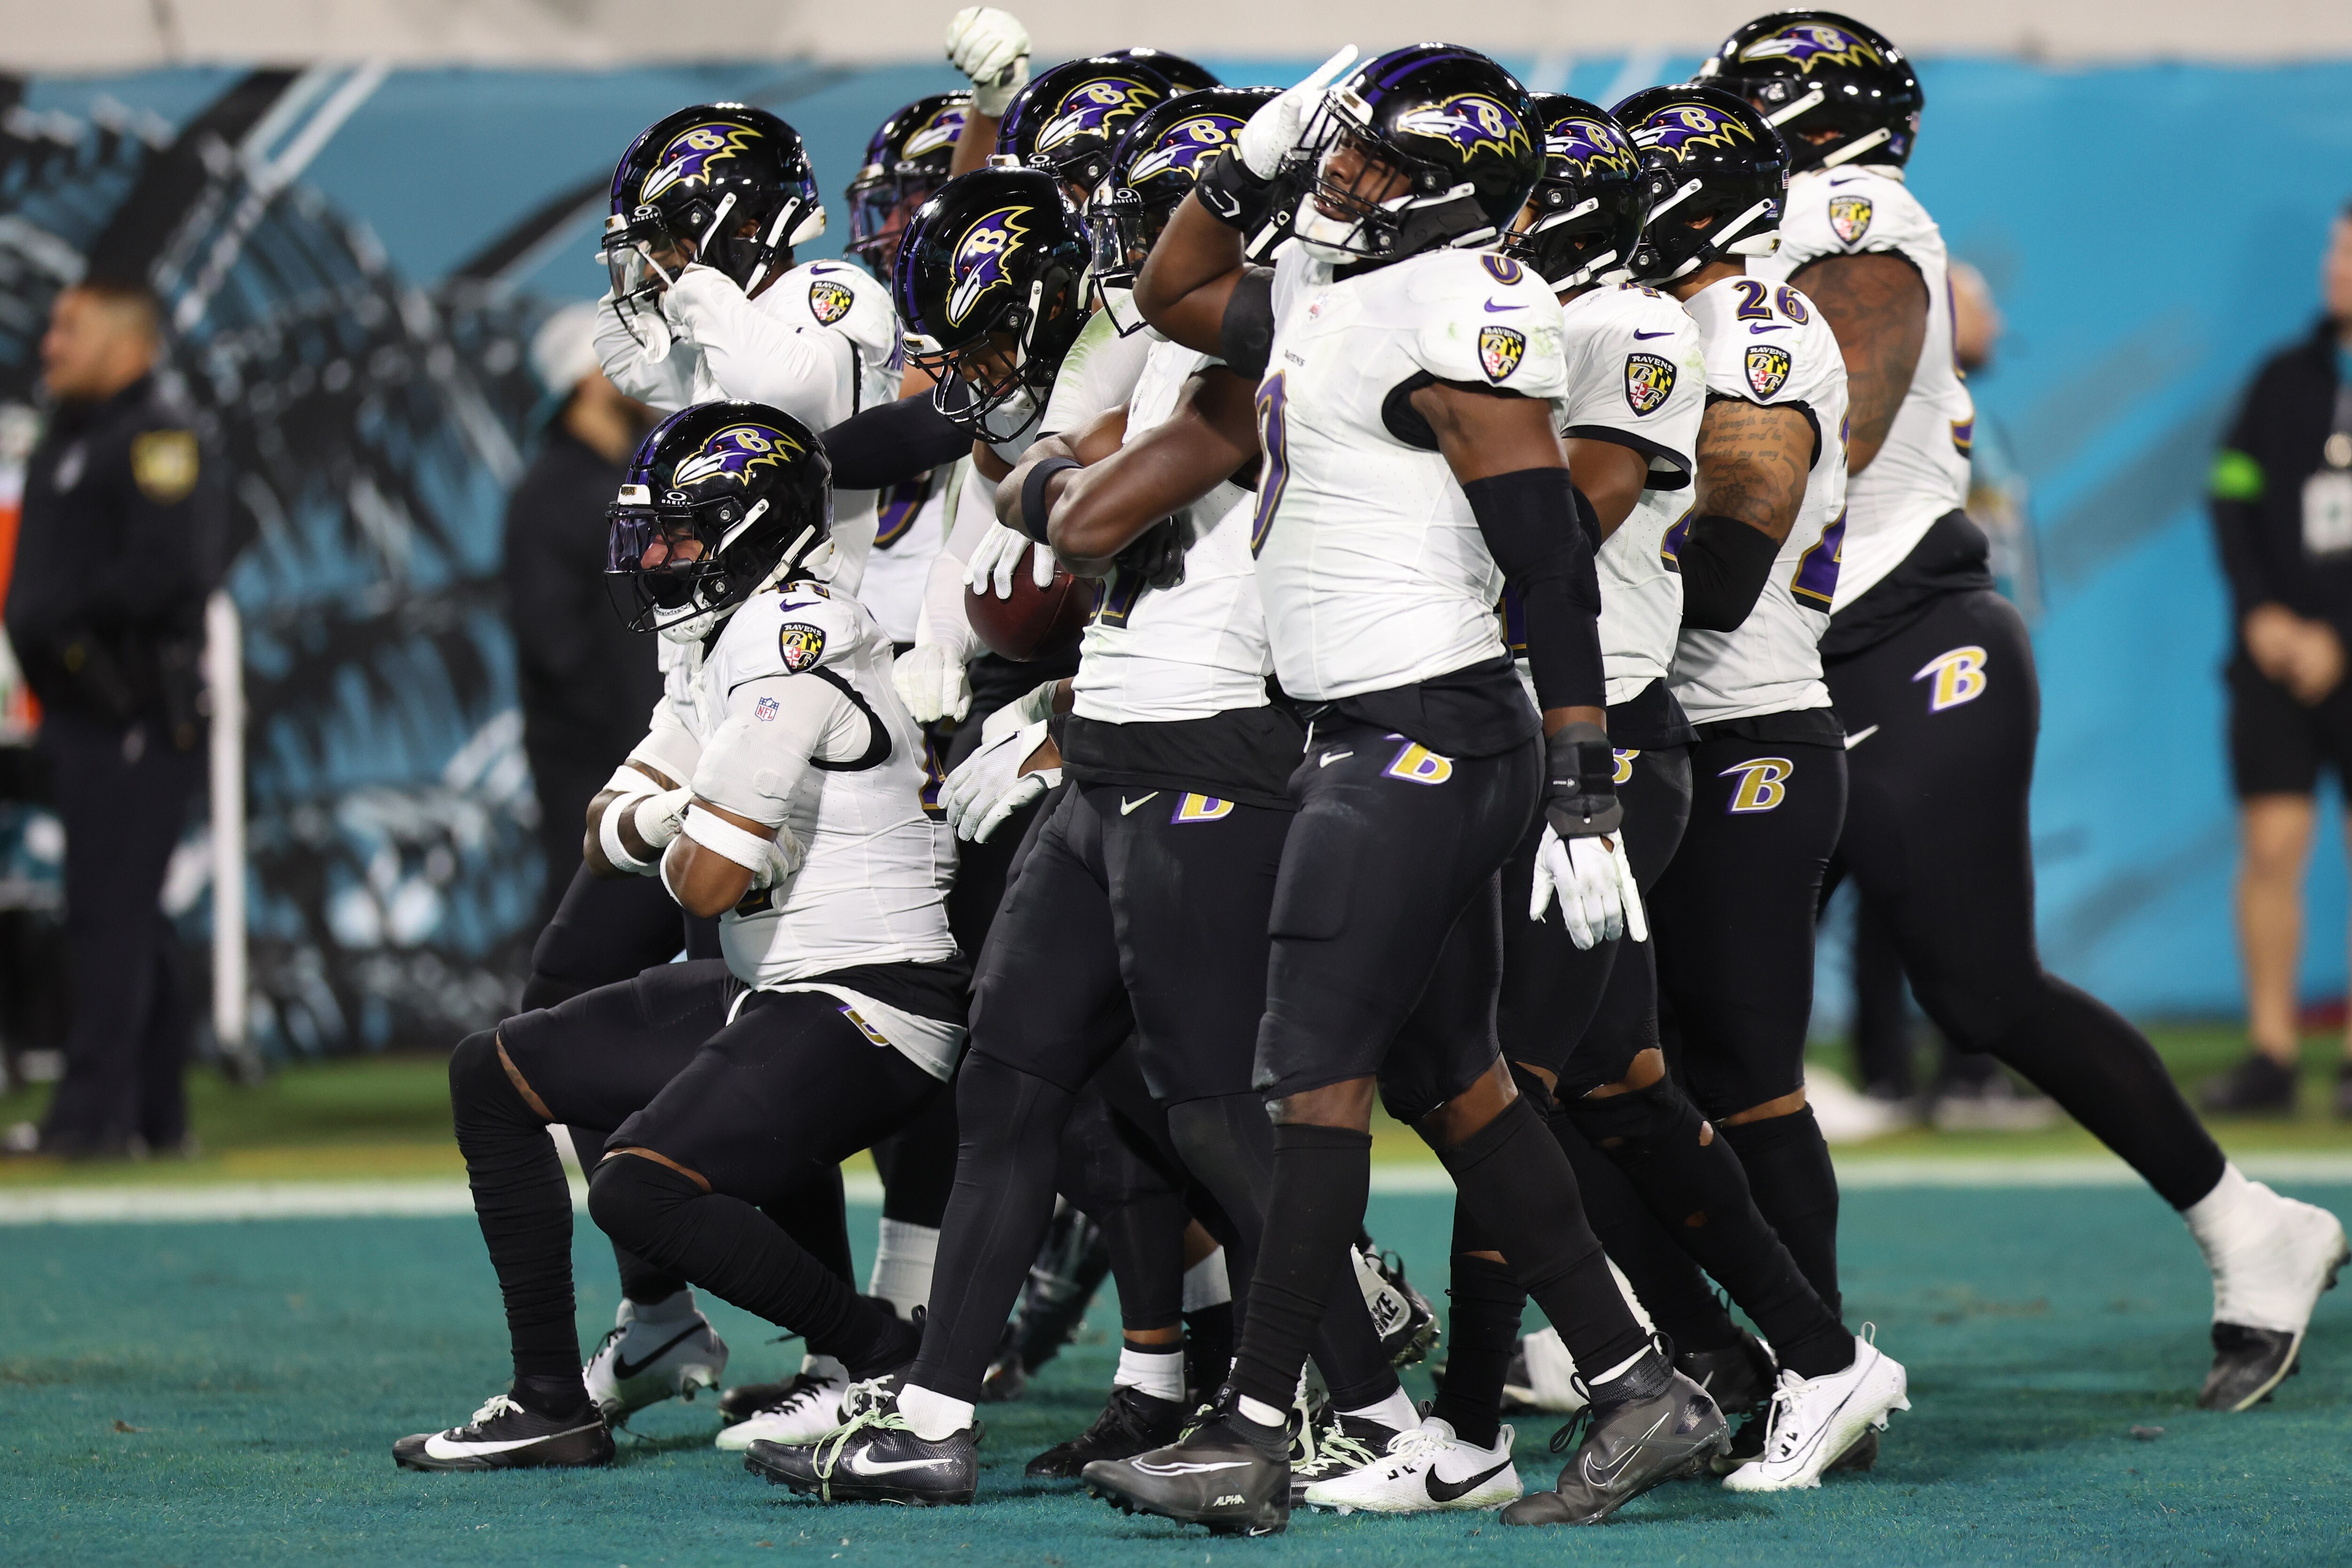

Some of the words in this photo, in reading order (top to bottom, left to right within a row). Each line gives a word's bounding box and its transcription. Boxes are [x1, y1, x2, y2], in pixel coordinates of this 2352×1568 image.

[631, 212, 659, 223] OAKLEY
[814, 282, 851, 296] RAVENS
[1731, 279, 1809, 325] 26
[1484, 327, 1523, 342] RAVENS
[1749, 347, 1788, 359] RAVENS
[1631, 355, 1673, 372] RAVENS
[715, 428, 771, 452] B
[784, 624, 822, 636] RAVENS
[1910, 644, 1988, 713] B
[756, 705, 773, 719] NFL
[1717, 756, 1794, 814] B
[1212, 1494, 1246, 1507] ALPHA
